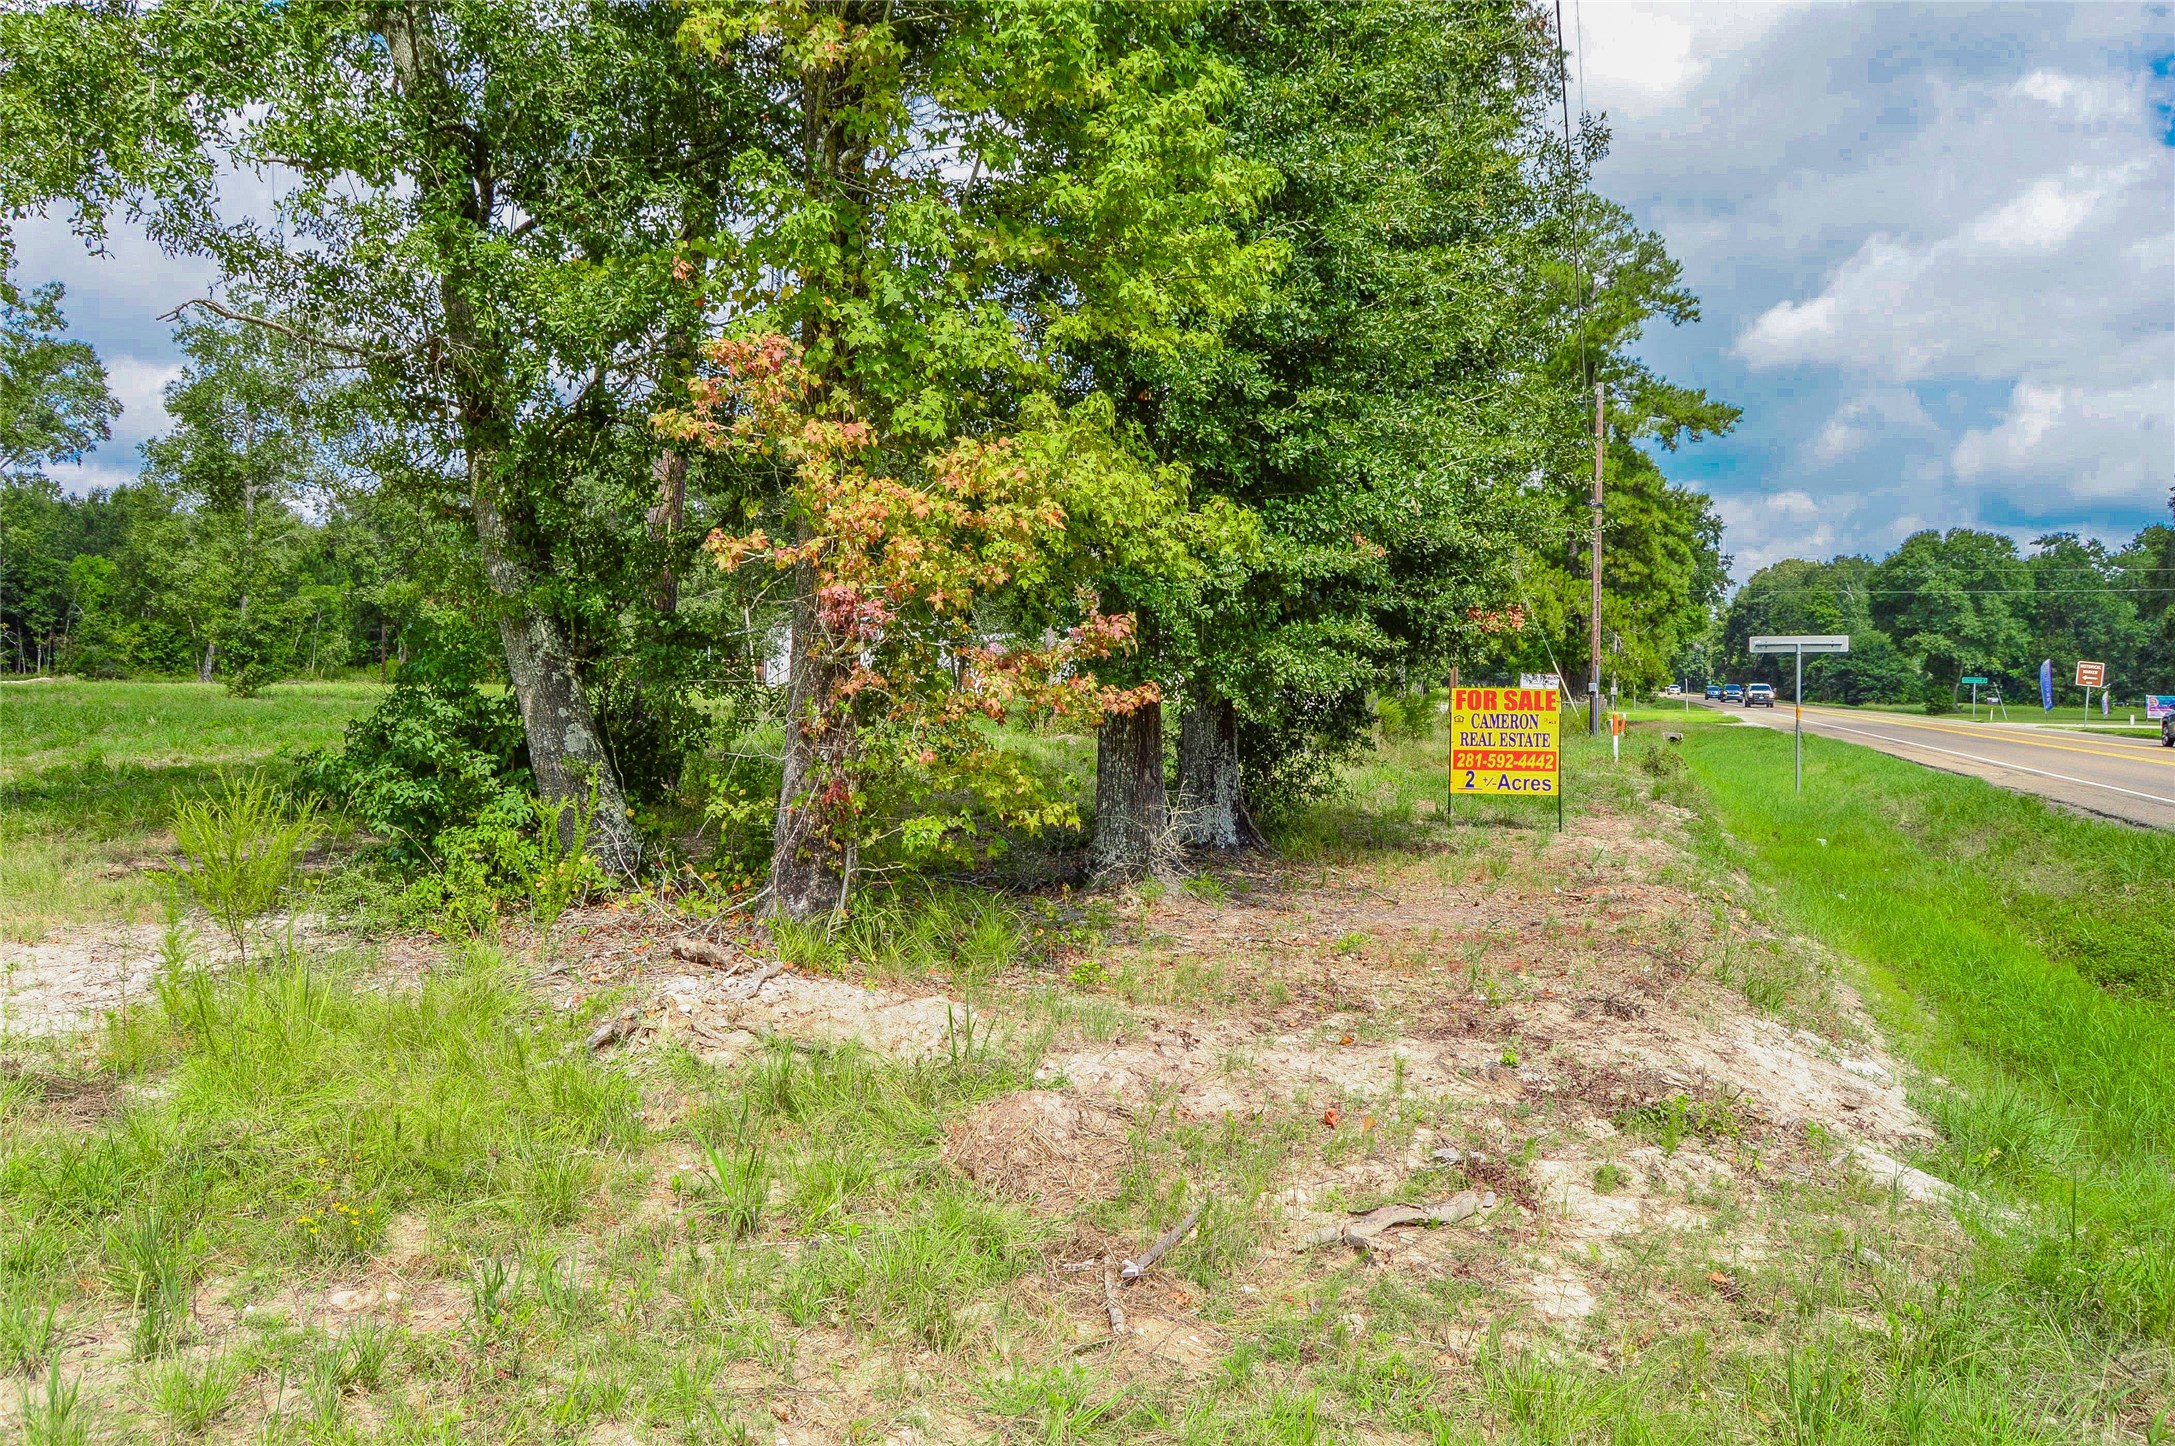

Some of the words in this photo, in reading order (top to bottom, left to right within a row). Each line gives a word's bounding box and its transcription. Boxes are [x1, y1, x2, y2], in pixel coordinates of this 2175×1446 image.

[1455, 690, 1497, 711] FOR
[1503, 690, 1557, 711] SALE
[1471, 713, 1539, 730] CAMERON
[1460, 732, 1496, 747] REAL
[1499, 732, 1551, 748] ESTATE
[1456, 753, 1554, 770] 281-592-4442
[1465, 770, 1476, 788] 2
[1497, 773, 1552, 791] Acres
